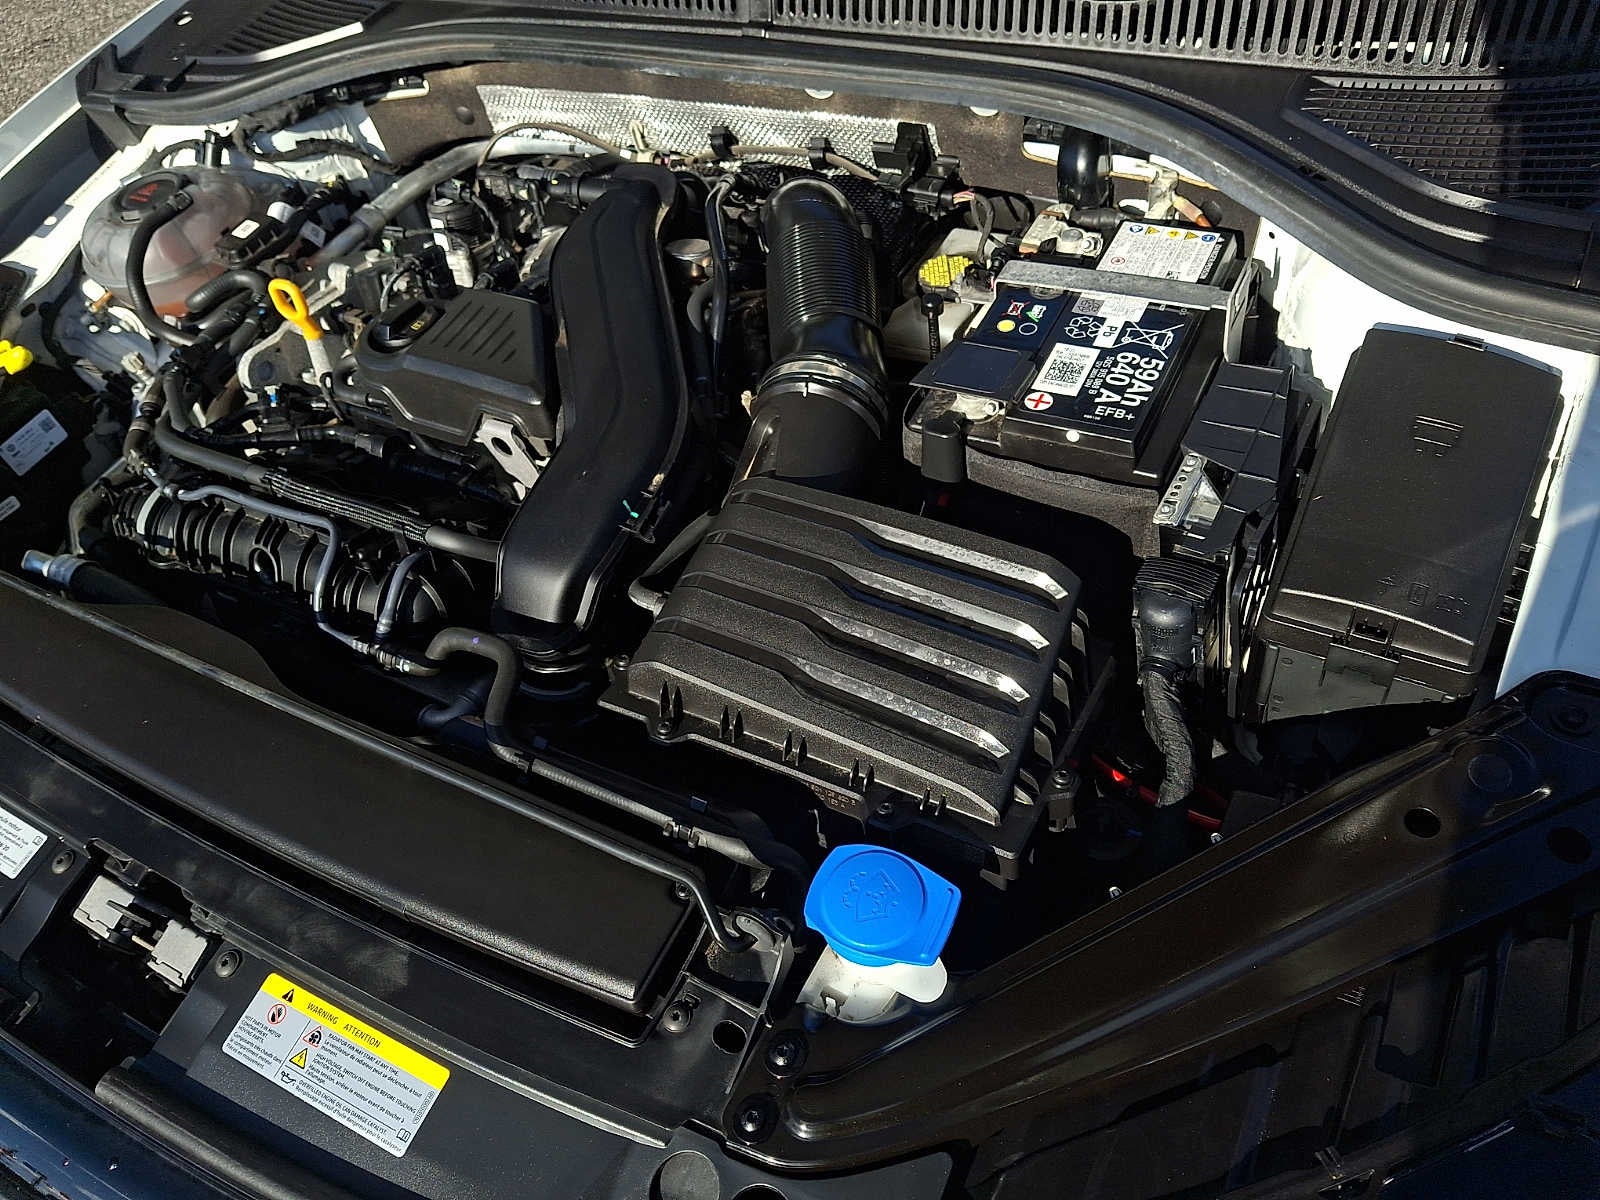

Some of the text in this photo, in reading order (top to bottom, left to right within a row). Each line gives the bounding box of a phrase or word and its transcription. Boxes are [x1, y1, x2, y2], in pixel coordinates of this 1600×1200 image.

[1102, 326, 1118, 337] Pb
[1105, 352, 1141, 386] 640
[1120, 356, 1165, 407] 59Ah
[1094, 387, 1122, 404] A
[1094, 405, 1136, 421] EFB+
[306, 1002, 381, 1048] WARNING ATTENTION
